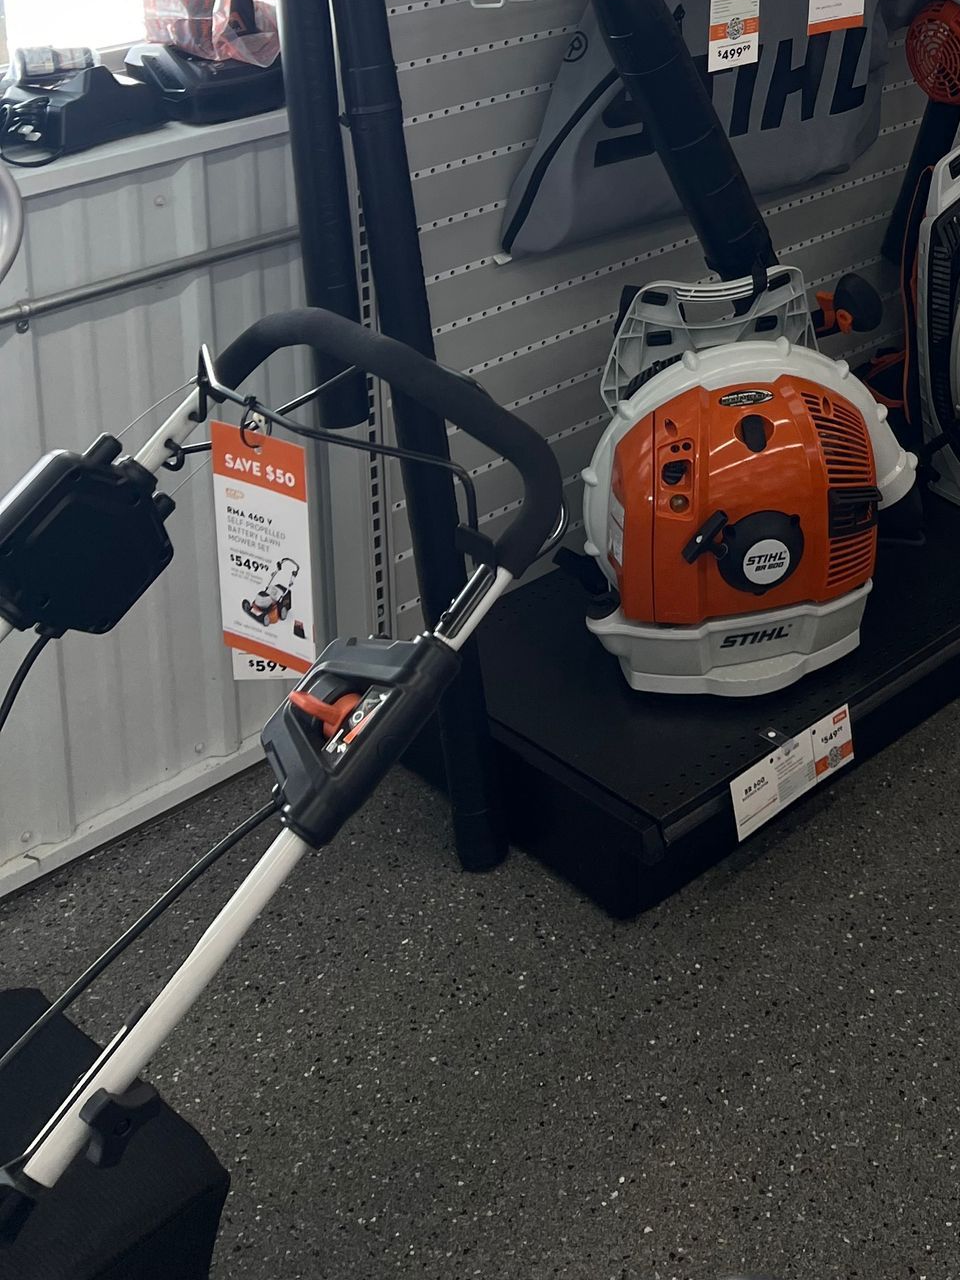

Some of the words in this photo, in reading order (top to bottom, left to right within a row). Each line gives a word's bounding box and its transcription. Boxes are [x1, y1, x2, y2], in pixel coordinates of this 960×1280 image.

[224, 453, 262, 477] SAVE
[265, 464, 296, 488] $50
[227, 506, 245, 518] RMA
[248, 513, 265, 523] 460
[227, 515, 243, 525] SELF
[246, 520, 286, 540] PROPELLED
[228, 524, 258, 541] BATTERY
[260, 536, 281, 547] LAWN
[228, 534, 256, 547] MOWER
[258, 542, 270, 552] SET
[746, 551, 787, 566] STIHL
[755, 563, 767, 572] BR
[720, 626, 790, 649] STIHL
